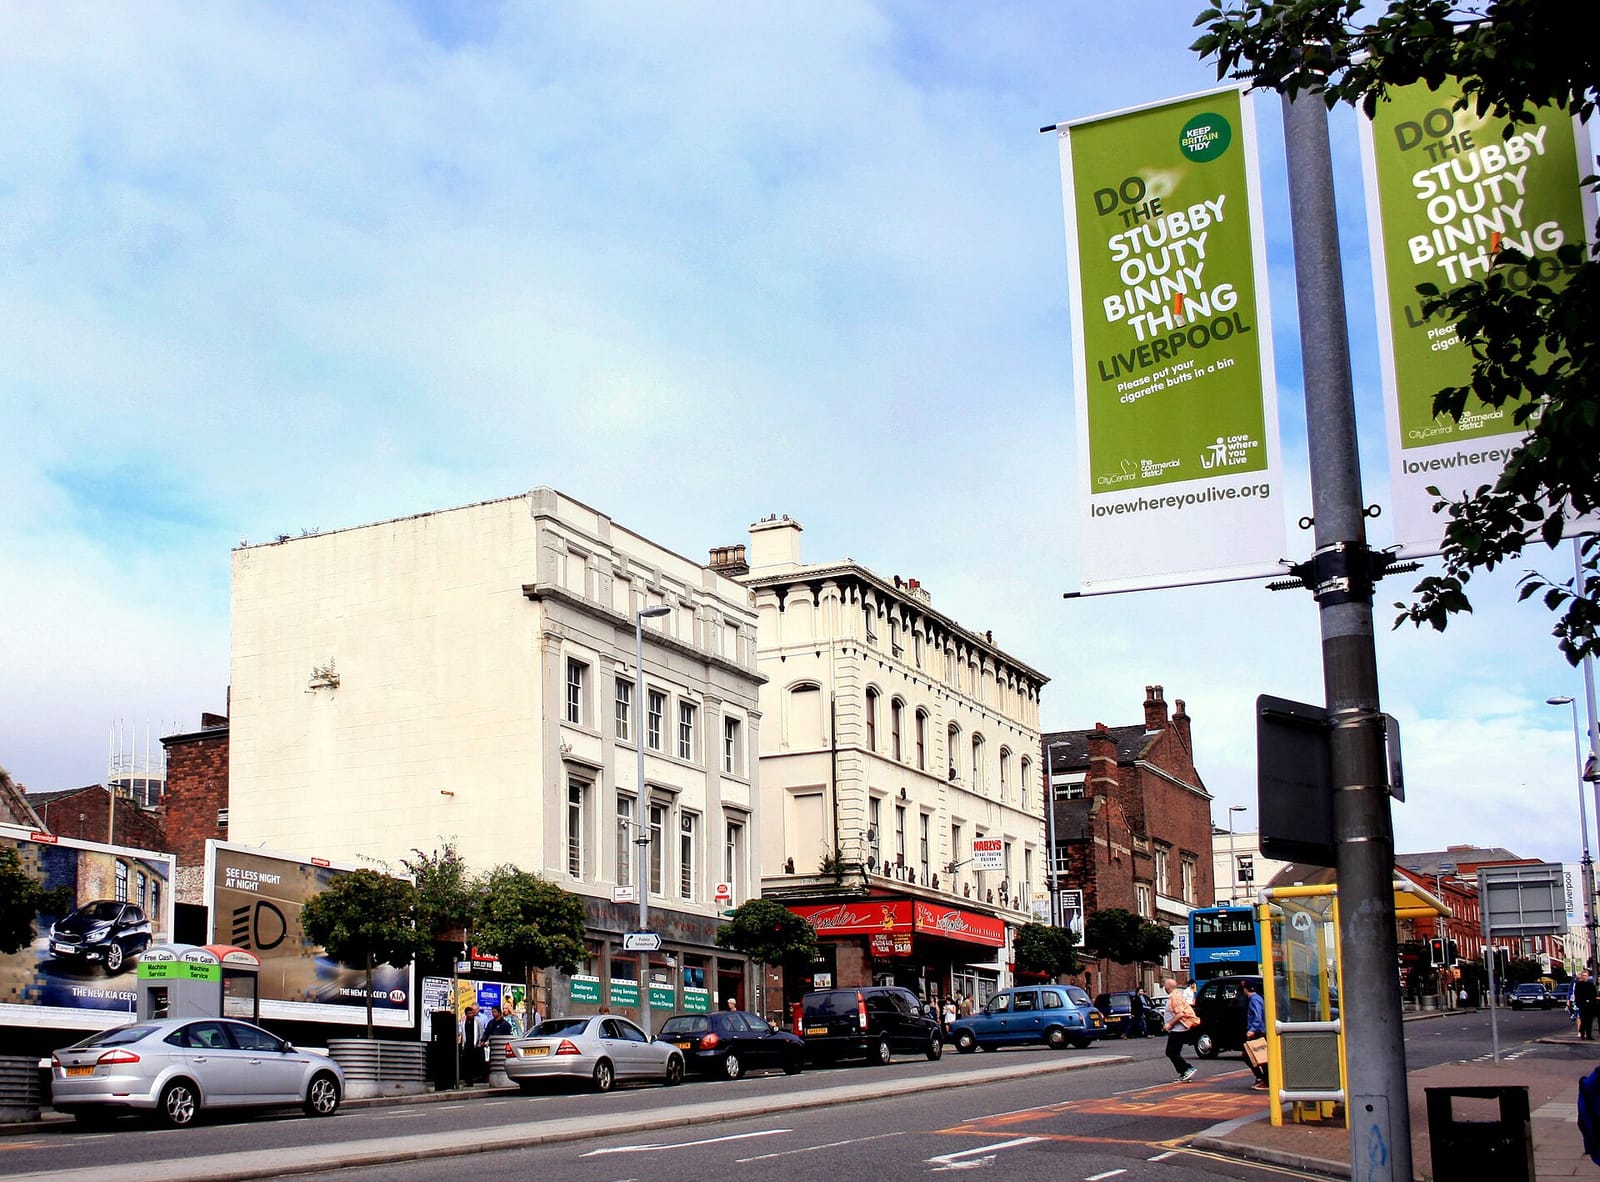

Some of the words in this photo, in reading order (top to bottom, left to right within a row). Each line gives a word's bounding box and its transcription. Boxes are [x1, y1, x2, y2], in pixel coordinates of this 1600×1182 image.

[1187, 126, 1210, 138] KEEP
[1394, 108, 1454, 151] DO
[1182, 132, 1218, 146] BRITAIN
[1188, 141, 1210, 152] TIDY
[1423, 129, 1475, 163] THE
[1412, 125, 1547, 200] STUBBY
[1093, 176, 1146, 216] DO
[1427, 165, 1527, 225] OUTY
[1118, 197, 1163, 227] THE
[1108, 195, 1225, 261] STUBBY
[1407, 198, 1524, 265] BINNY
[1120, 231, 1207, 285] OUTY
[1103, 262, 1204, 322] BINNY
[1127, 283, 1238, 341] THING
[1428, 323, 1458, 340] Pleas
[1097, 311, 1250, 381] LIVERPOOL
[1117, 375, 1150, 393] Please
[1153, 368, 1169, 382] put
[1171, 359, 1195, 375] your
[1120, 383, 1165, 404] cigarette
[1166, 373, 1192, 387] butts
[1195, 368, 1205, 378] in
[1207, 365, 1214, 373] a
[1217, 357, 1234, 370] bin
[1458, 410, 1503, 424] commercial
[1409, 426, 1453, 439] CityCentral
[1459, 421, 1484, 431] district
[1228, 440, 1258, 450] where
[1140, 458, 1152, 467] the
[1141, 459, 1180, 473] commercial
[1097, 472, 1136, 485] CityCentral
[1141, 470, 1163, 479] district
[1091, 483, 1270, 518] lovewhereyoulive.org
[226, 867, 240, 878] SEE
[241, 869, 258, 880] LESS
[260, 873, 280, 885] NIGHT
[226, 878, 234, 887] AT
[237, 879, 259, 891] NIGHT
[200, 955, 214, 964] Cash
[72, 987, 87, 997] THE
[88, 989, 105, 998] NEW
[106, 990, 118, 999] KIA
[119, 991, 137, 1001] CEE'D
[340, 988, 350, 996] THE
[351, 989, 363, 997] NEW
